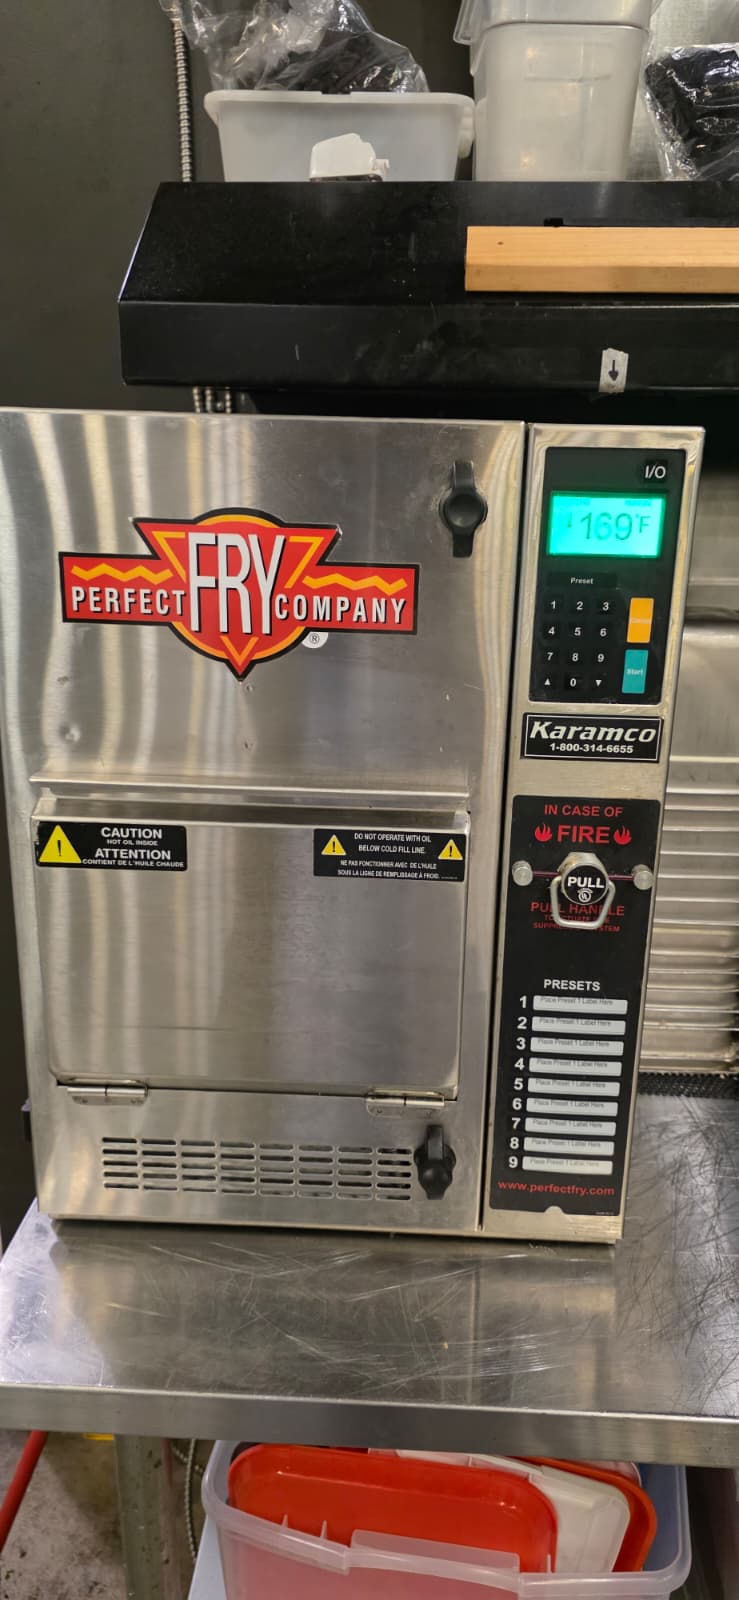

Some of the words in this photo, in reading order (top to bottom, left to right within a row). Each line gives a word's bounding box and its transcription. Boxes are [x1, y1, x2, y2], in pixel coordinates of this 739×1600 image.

[645, 465, 666, 479] I/O
[72, 586, 185, 615] PERFECT
[188, 532, 285, 635] FRY
[275, 594, 406, 624] COMPANY
[551, 601, 556, 609] 1
[577, 602, 583, 610] 2
[602, 602, 609, 610] 3
[548, 627, 555, 635] 4
[574, 628, 581, 636] 5
[601, 628, 607, 636] 6
[547, 653, 553, 661] 7
[572, 653, 578, 661] 8
[598, 654, 604, 662] 9
[570, 678, 577, 687] 0
[530, 721, 656, 742] Karamco
[550, 743, 633, 754] 1-800-314-6655
[544, 804, 558, 815] IN
[562, 805, 599, 817] CASE
[604, 807, 623, 817] OF
[101, 827, 162, 839] CAUTION
[557, 825, 610, 844] FIRE
[95, 848, 171, 860] ATTENTION
[568, 876, 605, 889] PULL
[530, 902, 565, 912] PUL
[569, 904, 624, 916] HANLE
[544, 979, 600, 991] PRESETS
[520, 996, 527, 1008] 1
[518, 1017, 527, 1029] 2
[516, 1037, 526, 1050] 3
[515, 1058, 524, 1070] 4
[514, 1078, 523, 1090] 5
[512, 1099, 522, 1110] 6
[512, 1118, 521, 1130] 7
[509, 1137, 519, 1149] 8
[509, 1156, 518, 1168] 9
[498, 1181, 615, 1197] www.perfectfry.com
